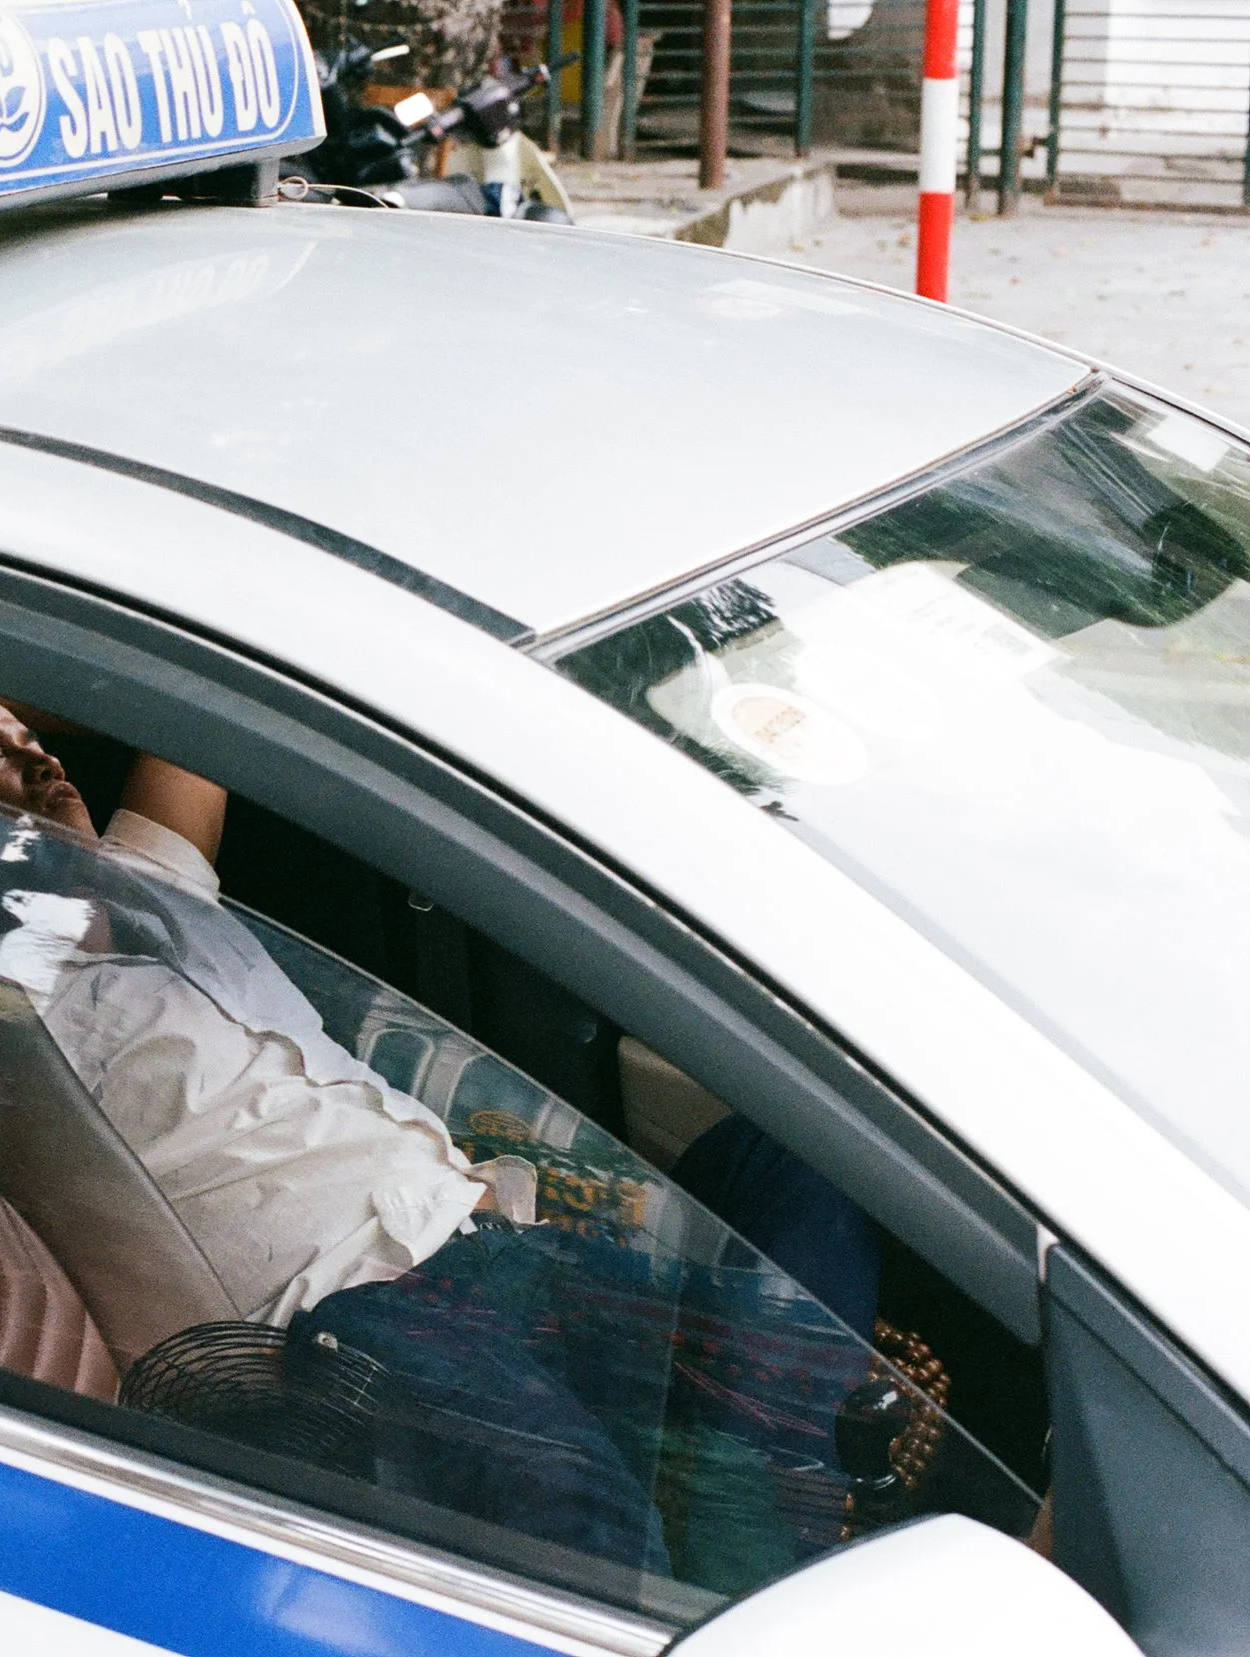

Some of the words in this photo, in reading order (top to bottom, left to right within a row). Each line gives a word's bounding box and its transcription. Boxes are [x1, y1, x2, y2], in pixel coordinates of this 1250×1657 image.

[48, 32, 142, 159] SAO
[137, 0, 224, 144] THỦ
[220, 0, 281, 132] ĐÔ
